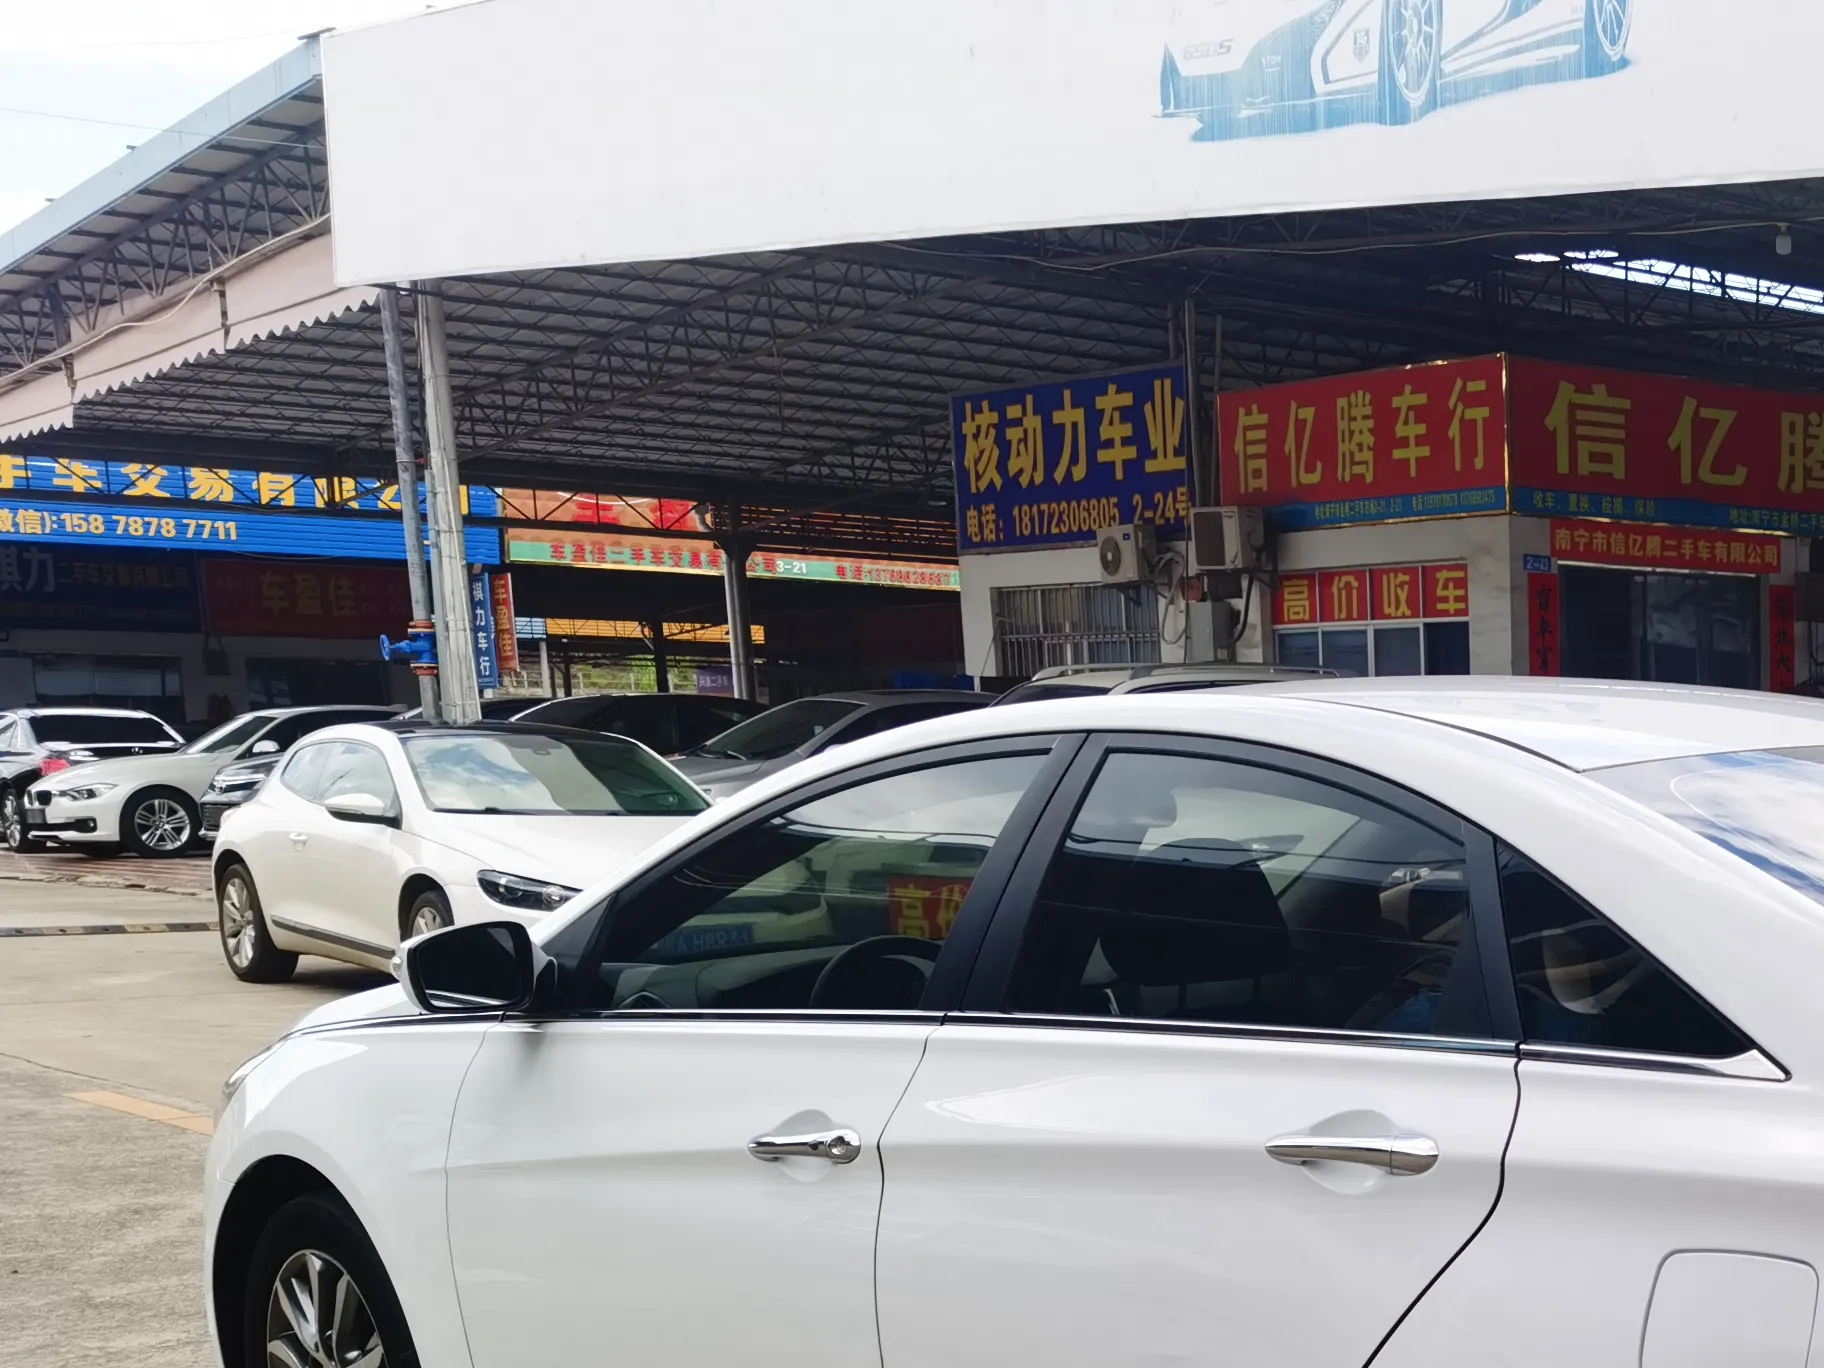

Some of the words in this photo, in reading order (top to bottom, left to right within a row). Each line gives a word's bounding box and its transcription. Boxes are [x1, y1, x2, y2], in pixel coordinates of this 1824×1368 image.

[962, 378, 1187, 493] 核动力车业
[1234, 376, 1490, 494] 信亿腾车行
[111, 514, 176, 538] 7878
[182, 518, 238, 541] 7711
[1012, 496, 1120, 537] 18172306805
[1555, 526, 1779, 566] 南宁市信亿腾二手车有限公司
[1283, 569, 1466, 622] 高价收车
